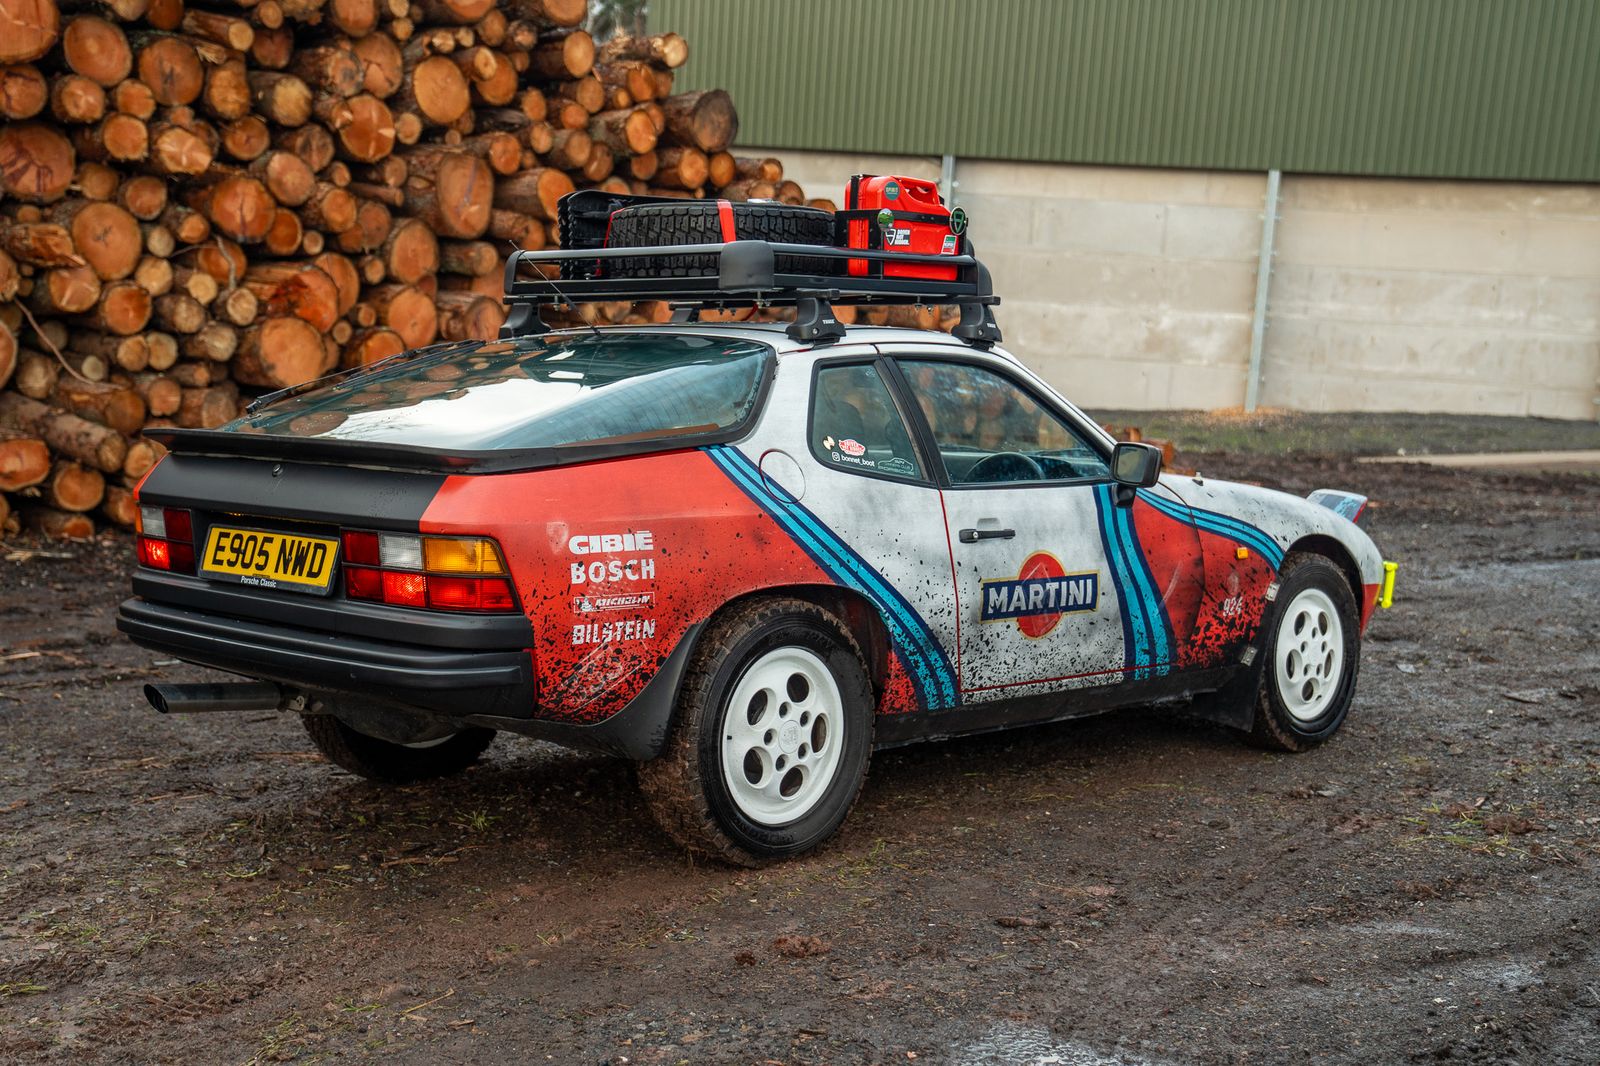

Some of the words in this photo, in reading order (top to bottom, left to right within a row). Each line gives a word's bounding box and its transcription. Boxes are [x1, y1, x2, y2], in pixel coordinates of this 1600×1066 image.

[211, 531, 275, 572] E905
[273, 538, 328, 579] NWD
[240, 576, 259, 586] Porsche
[259, 579, 277, 588] Classic
[570, 558, 655, 584] BOSCH
[594, 595, 650, 607] MICHELIN
[987, 578, 1093, 615] MARTINI
[571, 619, 656, 645] BILSTEIN
